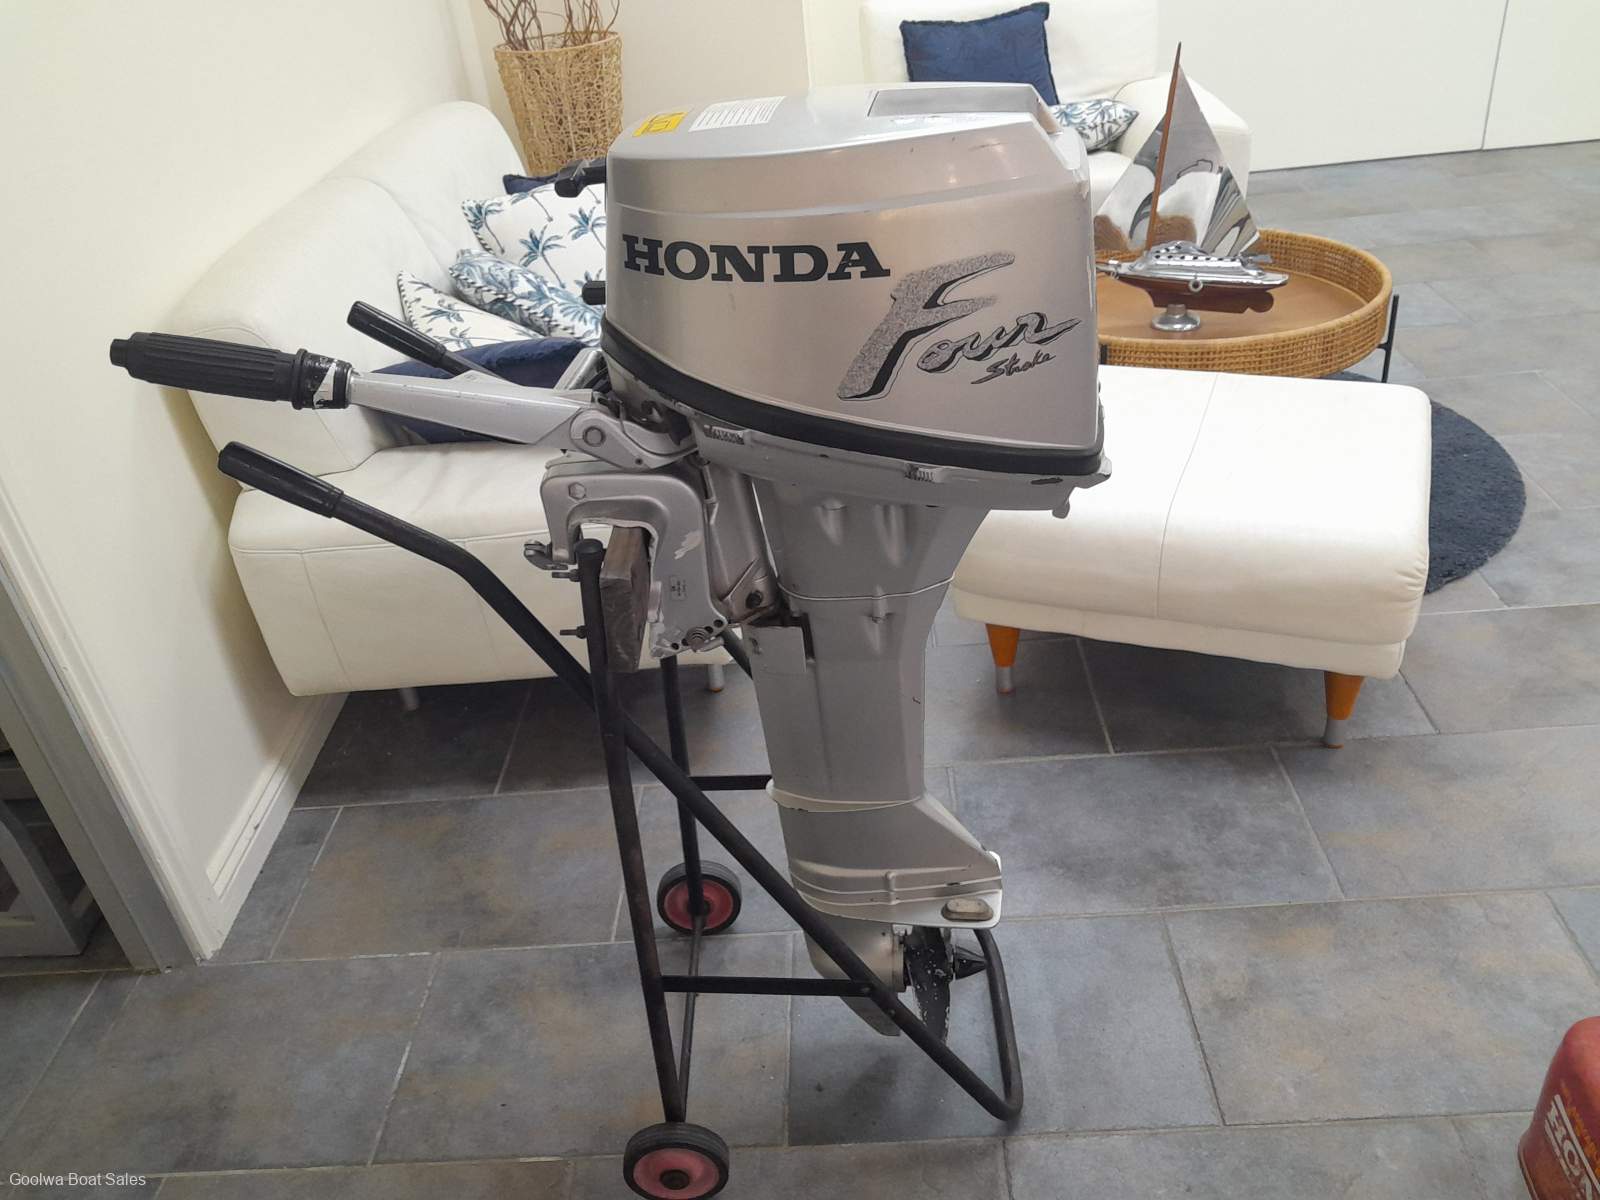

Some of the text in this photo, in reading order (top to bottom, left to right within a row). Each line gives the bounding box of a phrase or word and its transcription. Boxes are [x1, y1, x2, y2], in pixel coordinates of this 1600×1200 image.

[622, 233, 891, 283] HONDA
[836, 252, 1082, 401] Four
[970, 349, 1056, 385] Stroke
